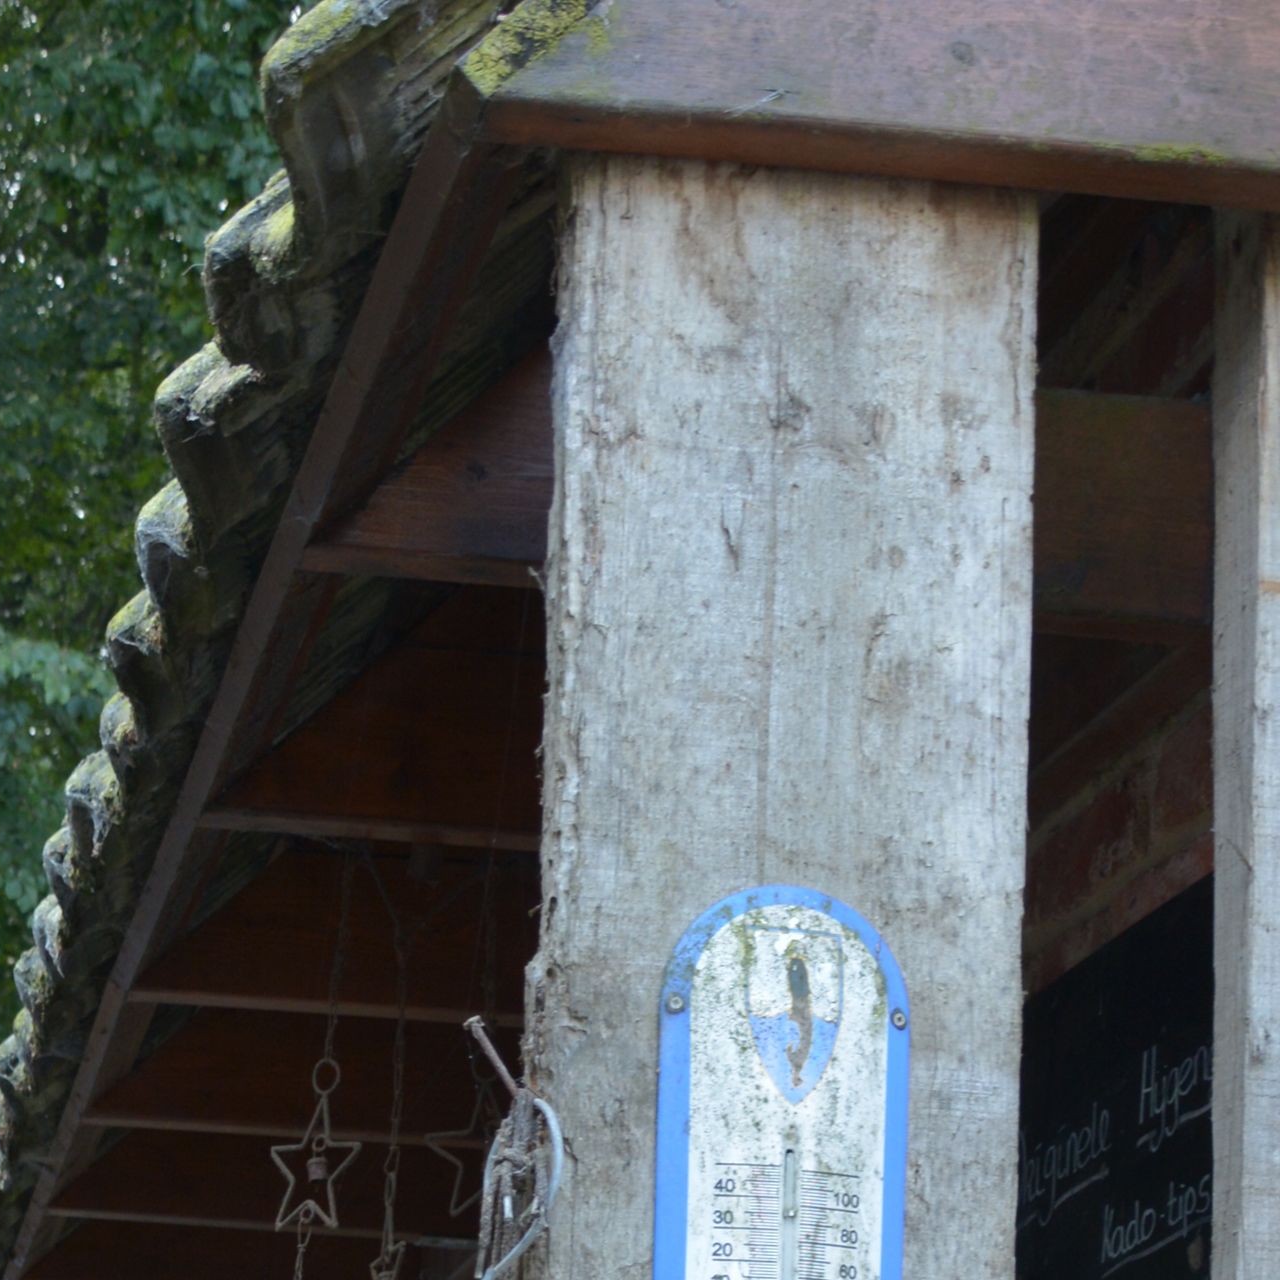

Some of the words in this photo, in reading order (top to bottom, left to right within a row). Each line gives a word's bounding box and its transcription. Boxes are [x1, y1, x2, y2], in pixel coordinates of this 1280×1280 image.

[714, 1178, 735, 1193] 40
[834, 1192, 860, 1208] 100
[713, 1210, 734, 1224] 30
[1100, 1173, 1211, 1265] Kado-tips
[841, 1229, 858, 1244] 80
[711, 1242, 733, 1257] 20
[839, 1264, 857, 1280] 60
